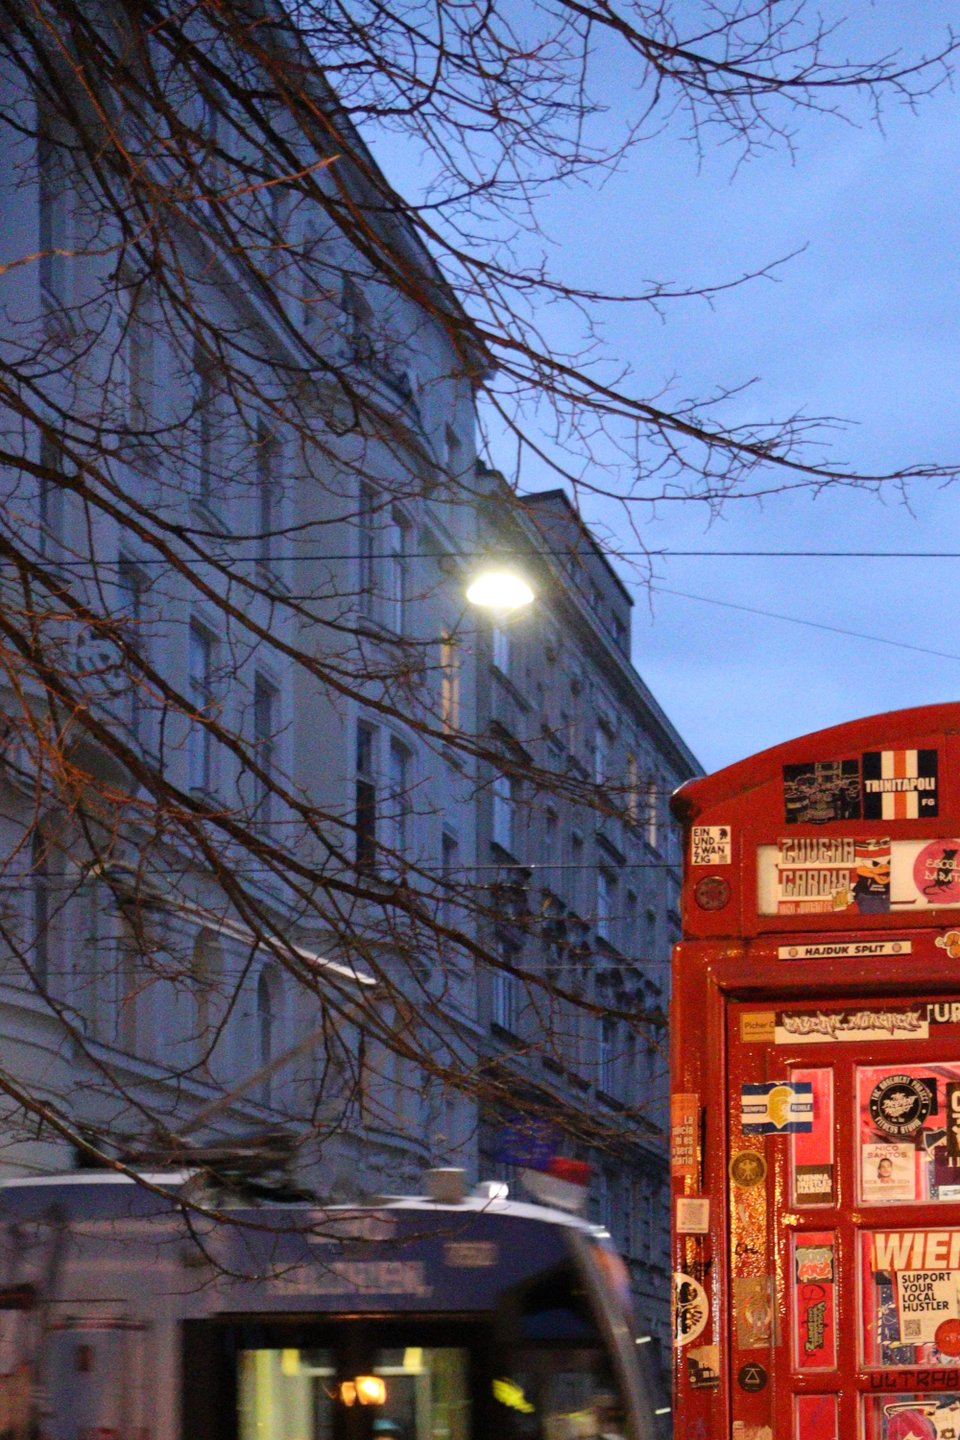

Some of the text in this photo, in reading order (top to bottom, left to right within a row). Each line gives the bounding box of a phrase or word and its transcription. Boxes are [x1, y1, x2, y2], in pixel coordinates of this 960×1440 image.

[865, 777, 936, 793] TRINITAPOLI
[921, 798, 935, 806] FG
[693, 828, 711, 837] EIN
[693, 837, 715, 846] UND
[693, 845, 725, 855] ZWAN
[693, 855, 711, 864] ZIG
[805, 944, 885, 956] HAJDUK SPLIT
[901, 1271, 952, 1284] SUPPORT
[902, 1283, 934, 1294] YOUR
[902, 1293, 937, 1304] LOCAL
[902, 1300, 949, 1313] HUSTLER
